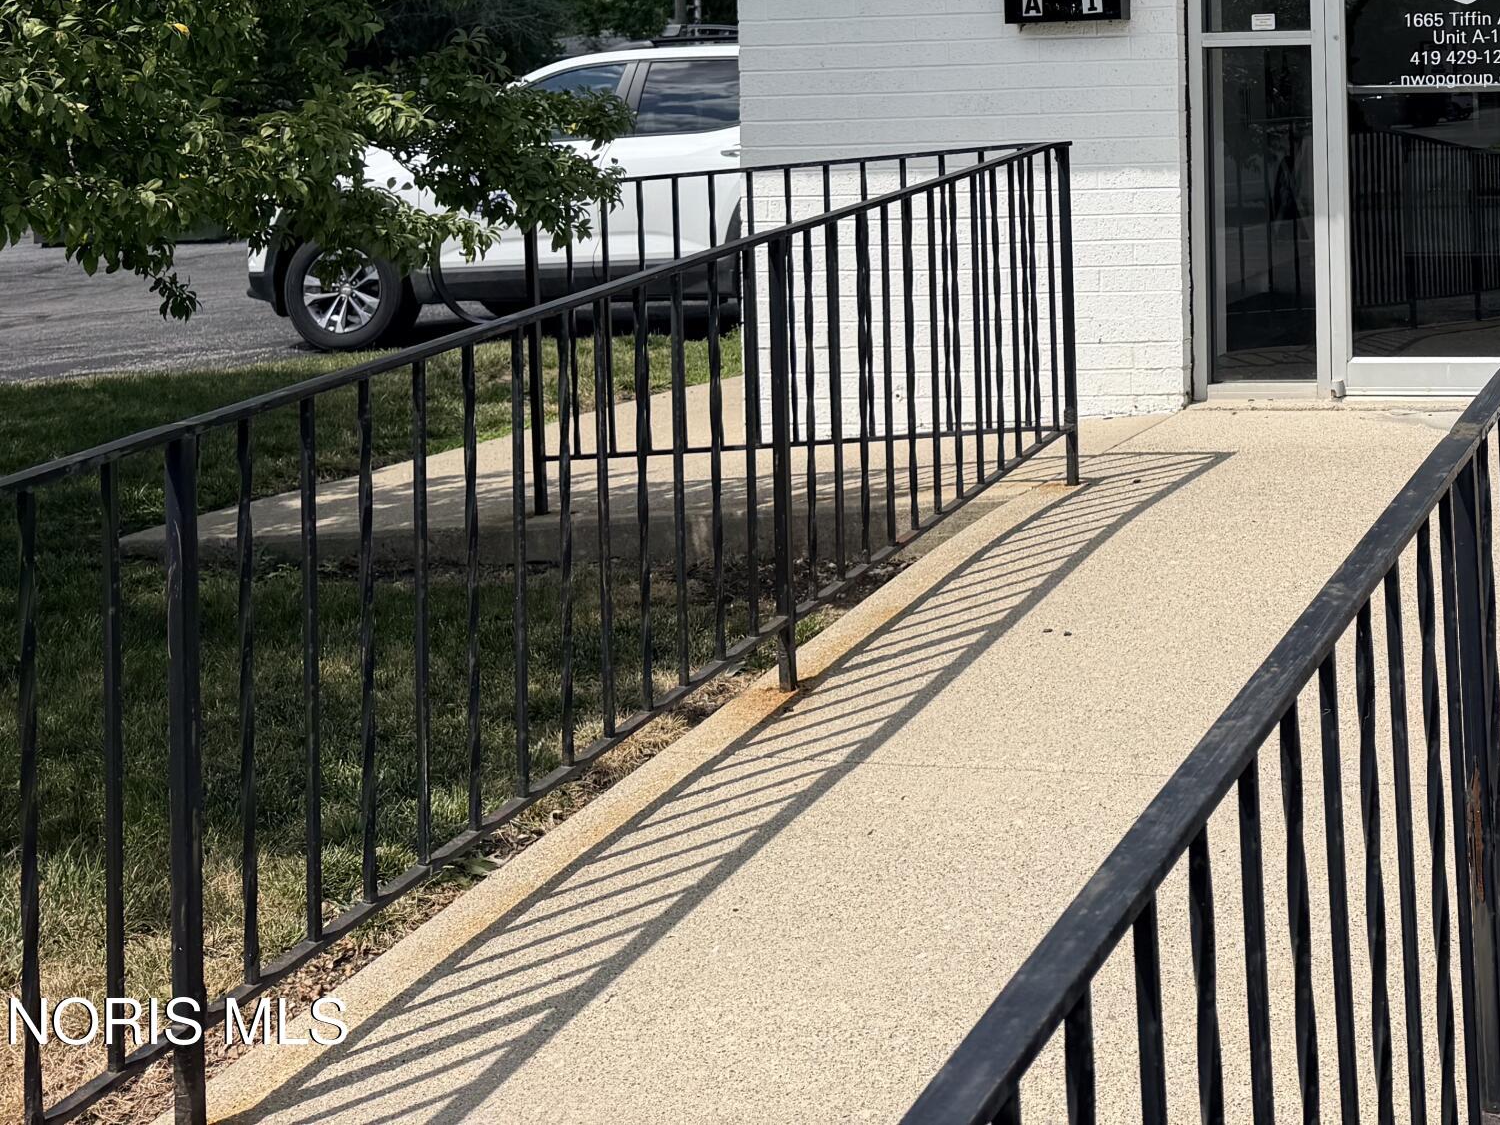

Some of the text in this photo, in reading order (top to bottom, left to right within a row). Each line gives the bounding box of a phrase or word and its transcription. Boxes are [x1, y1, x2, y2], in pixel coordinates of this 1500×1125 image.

[1404, 13, 1444, 27] 1665
[1449, 11, 1492, 26] Tiffin
[1433, 28, 1498, 44] Unit A-1
[1410, 51, 1441, 65] 419
